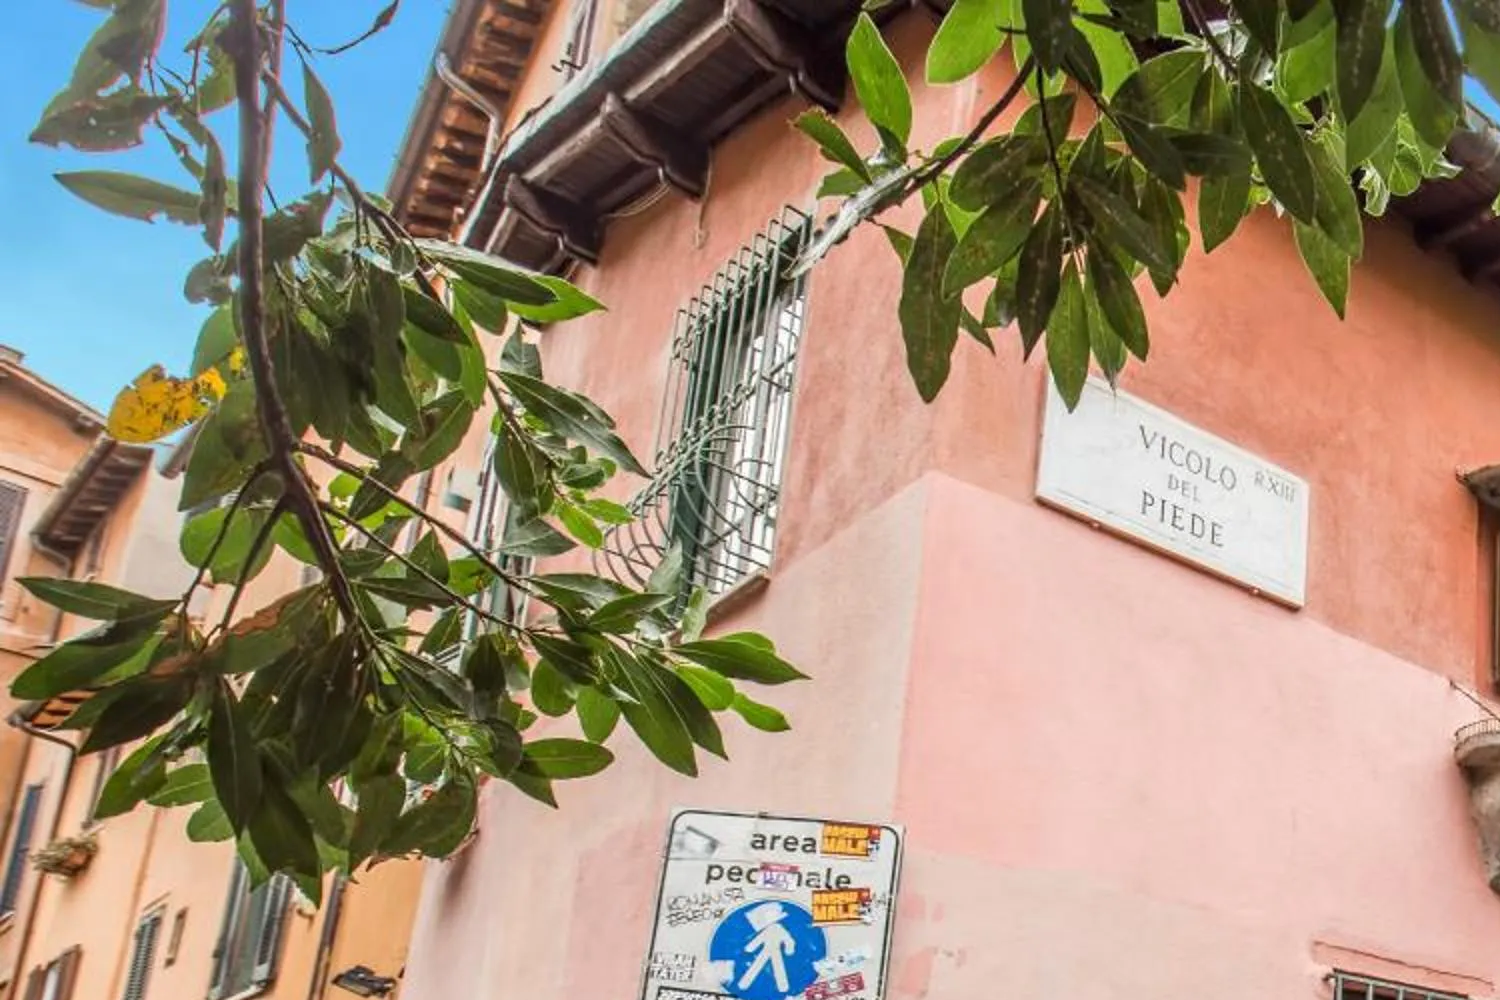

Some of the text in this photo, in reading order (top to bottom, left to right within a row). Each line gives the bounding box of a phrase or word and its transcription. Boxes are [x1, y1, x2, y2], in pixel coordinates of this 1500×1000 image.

[1139, 424, 1237, 491] VICOLO
[1166, 473, 1201, 503] DEL
[1141, 490, 1224, 548] PIEDE
[750, 832, 817, 853] area
